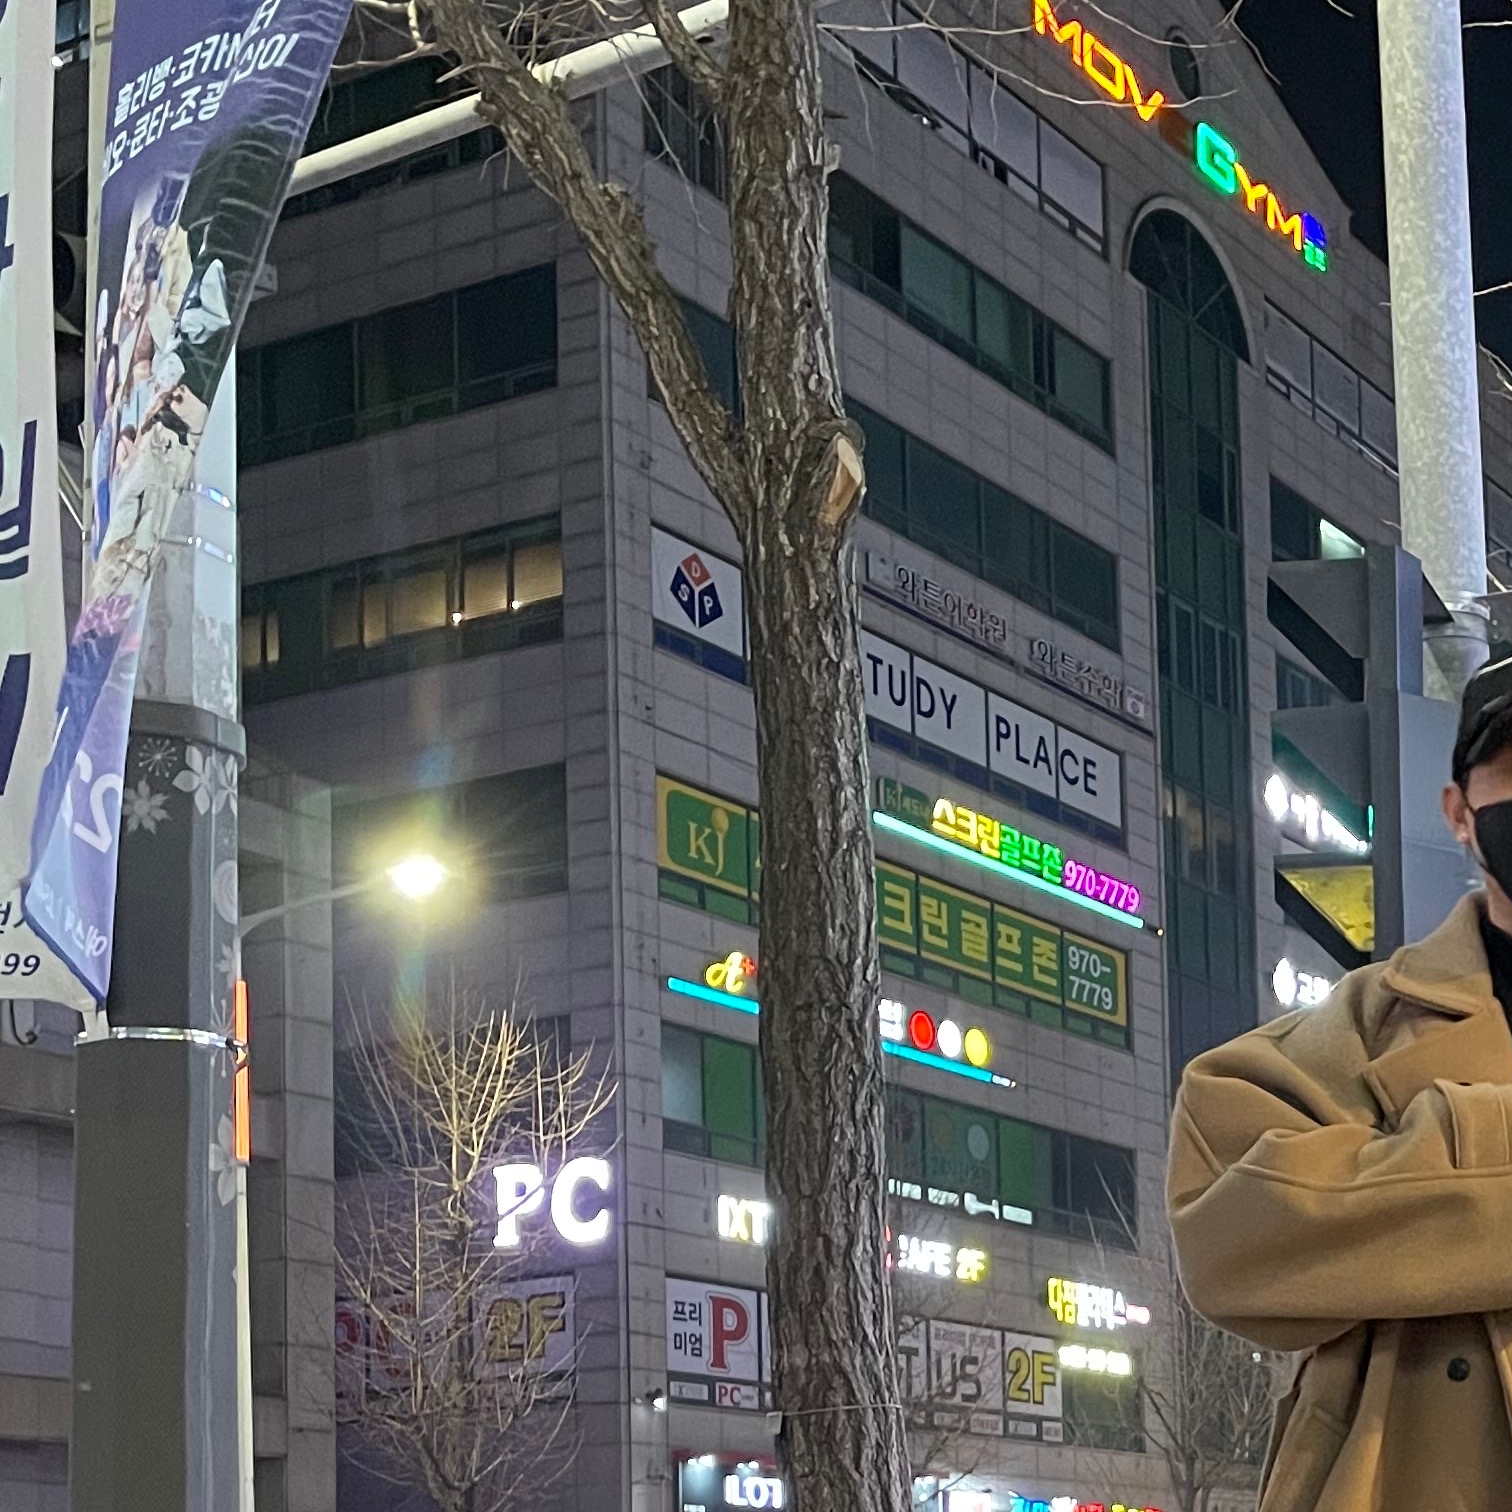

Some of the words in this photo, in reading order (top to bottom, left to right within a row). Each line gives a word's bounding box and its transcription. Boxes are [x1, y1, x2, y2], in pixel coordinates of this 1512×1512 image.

[1196, 121, 1302, 251] GYM
[996, 713, 1097, 796] PLACE
[932, 797, 1063, 883] 스크린골프존
[1064, 859, 1140, 913] 970-7779
[1068, 946, 1111, 977] 970-
[1069, 975, 1113, 1010] 7779
[492, 1157, 610, 1248] PC
[487, 1291, 566, 1362] 2F
[672, 1300, 702, 1326] 프리
[706, 1290, 750, 1373] P
[673, 1332, 703, 1358] 미엄
[1006, 1347, 1056, 1406] 2F
